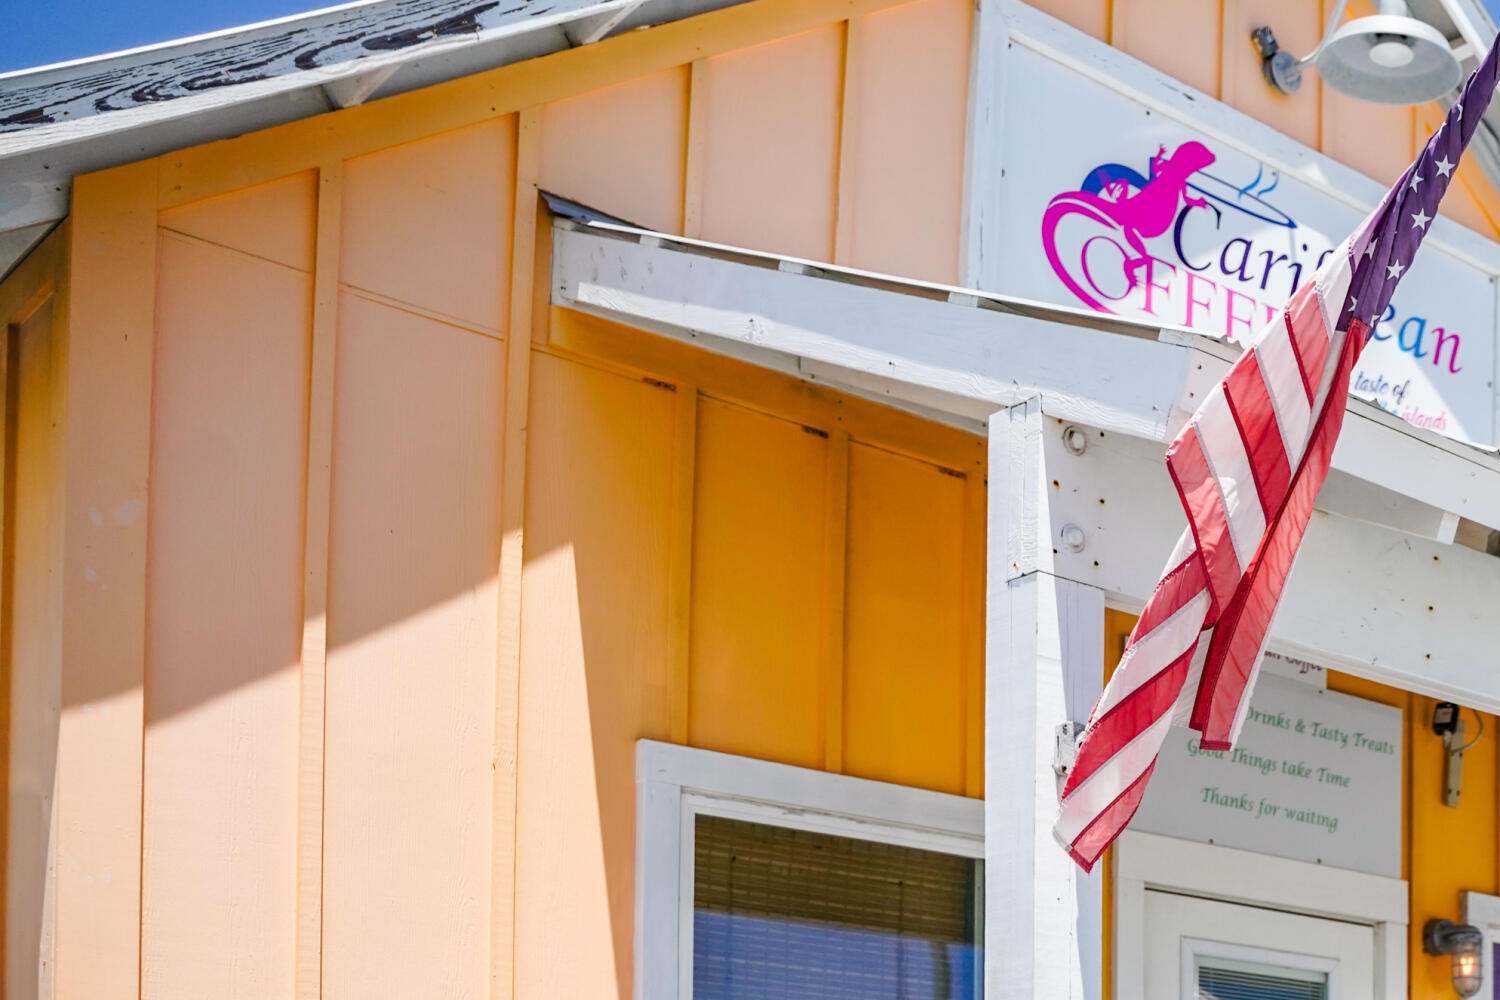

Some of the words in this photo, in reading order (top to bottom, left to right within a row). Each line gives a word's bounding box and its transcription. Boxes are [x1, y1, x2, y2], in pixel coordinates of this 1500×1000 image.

[1354, 371, 1388, 394] taste
[1392, 380, 1410, 405] of
[1295, 719, 1305, 734] &
[1311, 722, 1349, 749] Tasty
[1353, 732, 1395, 755] Treats
[1231, 748, 1277, 775] Things
[1282, 761, 1312, 778] take
[1318, 767, 1351, 787] Time
[1200, 787, 1253, 811] Thanks
[1255, 797, 1280, 819] for
[1284, 807, 1338, 834] waiting
